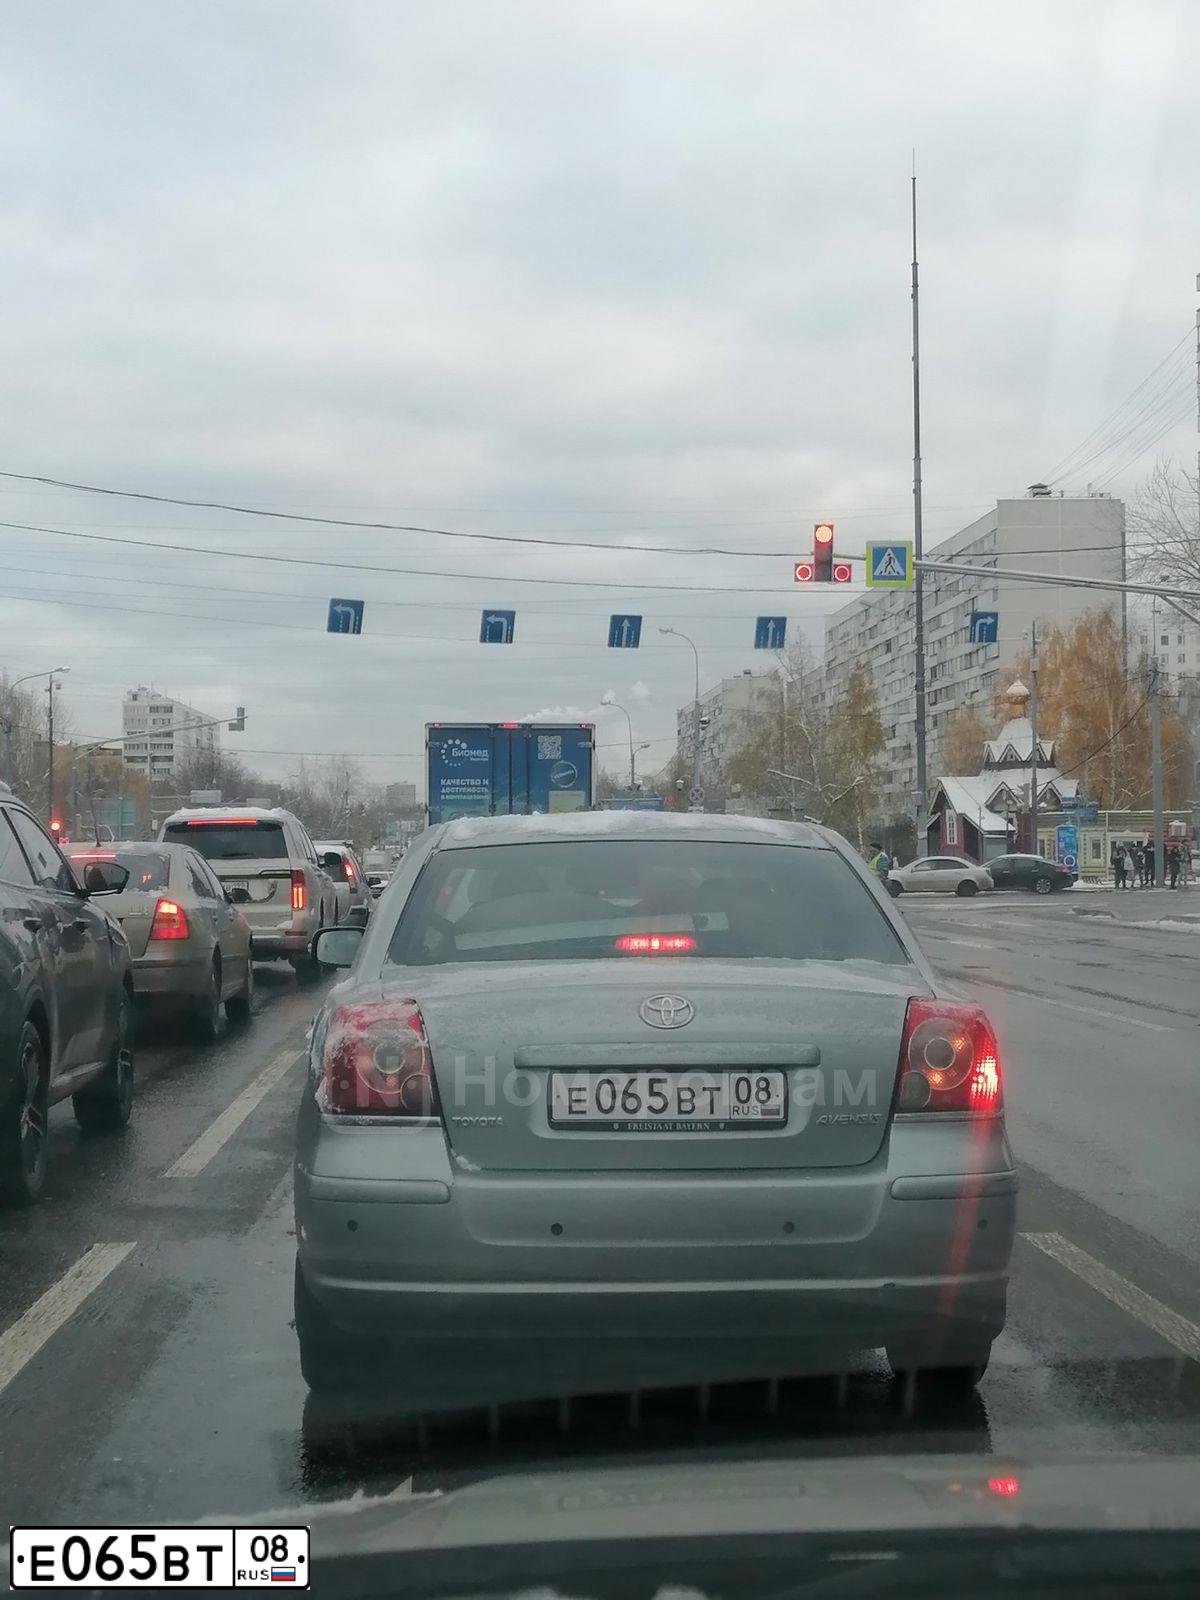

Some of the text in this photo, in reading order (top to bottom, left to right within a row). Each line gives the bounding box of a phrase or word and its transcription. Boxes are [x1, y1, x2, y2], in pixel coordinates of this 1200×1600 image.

[440, 778, 481, 786] КАЧЕСТВО
[735, 1076, 771, 1104] 08
[732, 1105, 759, 1116] RUS
[451, 1116, 503, 1127] TOYOTA
[816, 1112, 882, 1126] AVENSIS
[675, 1122, 711, 1130] BAYERN
